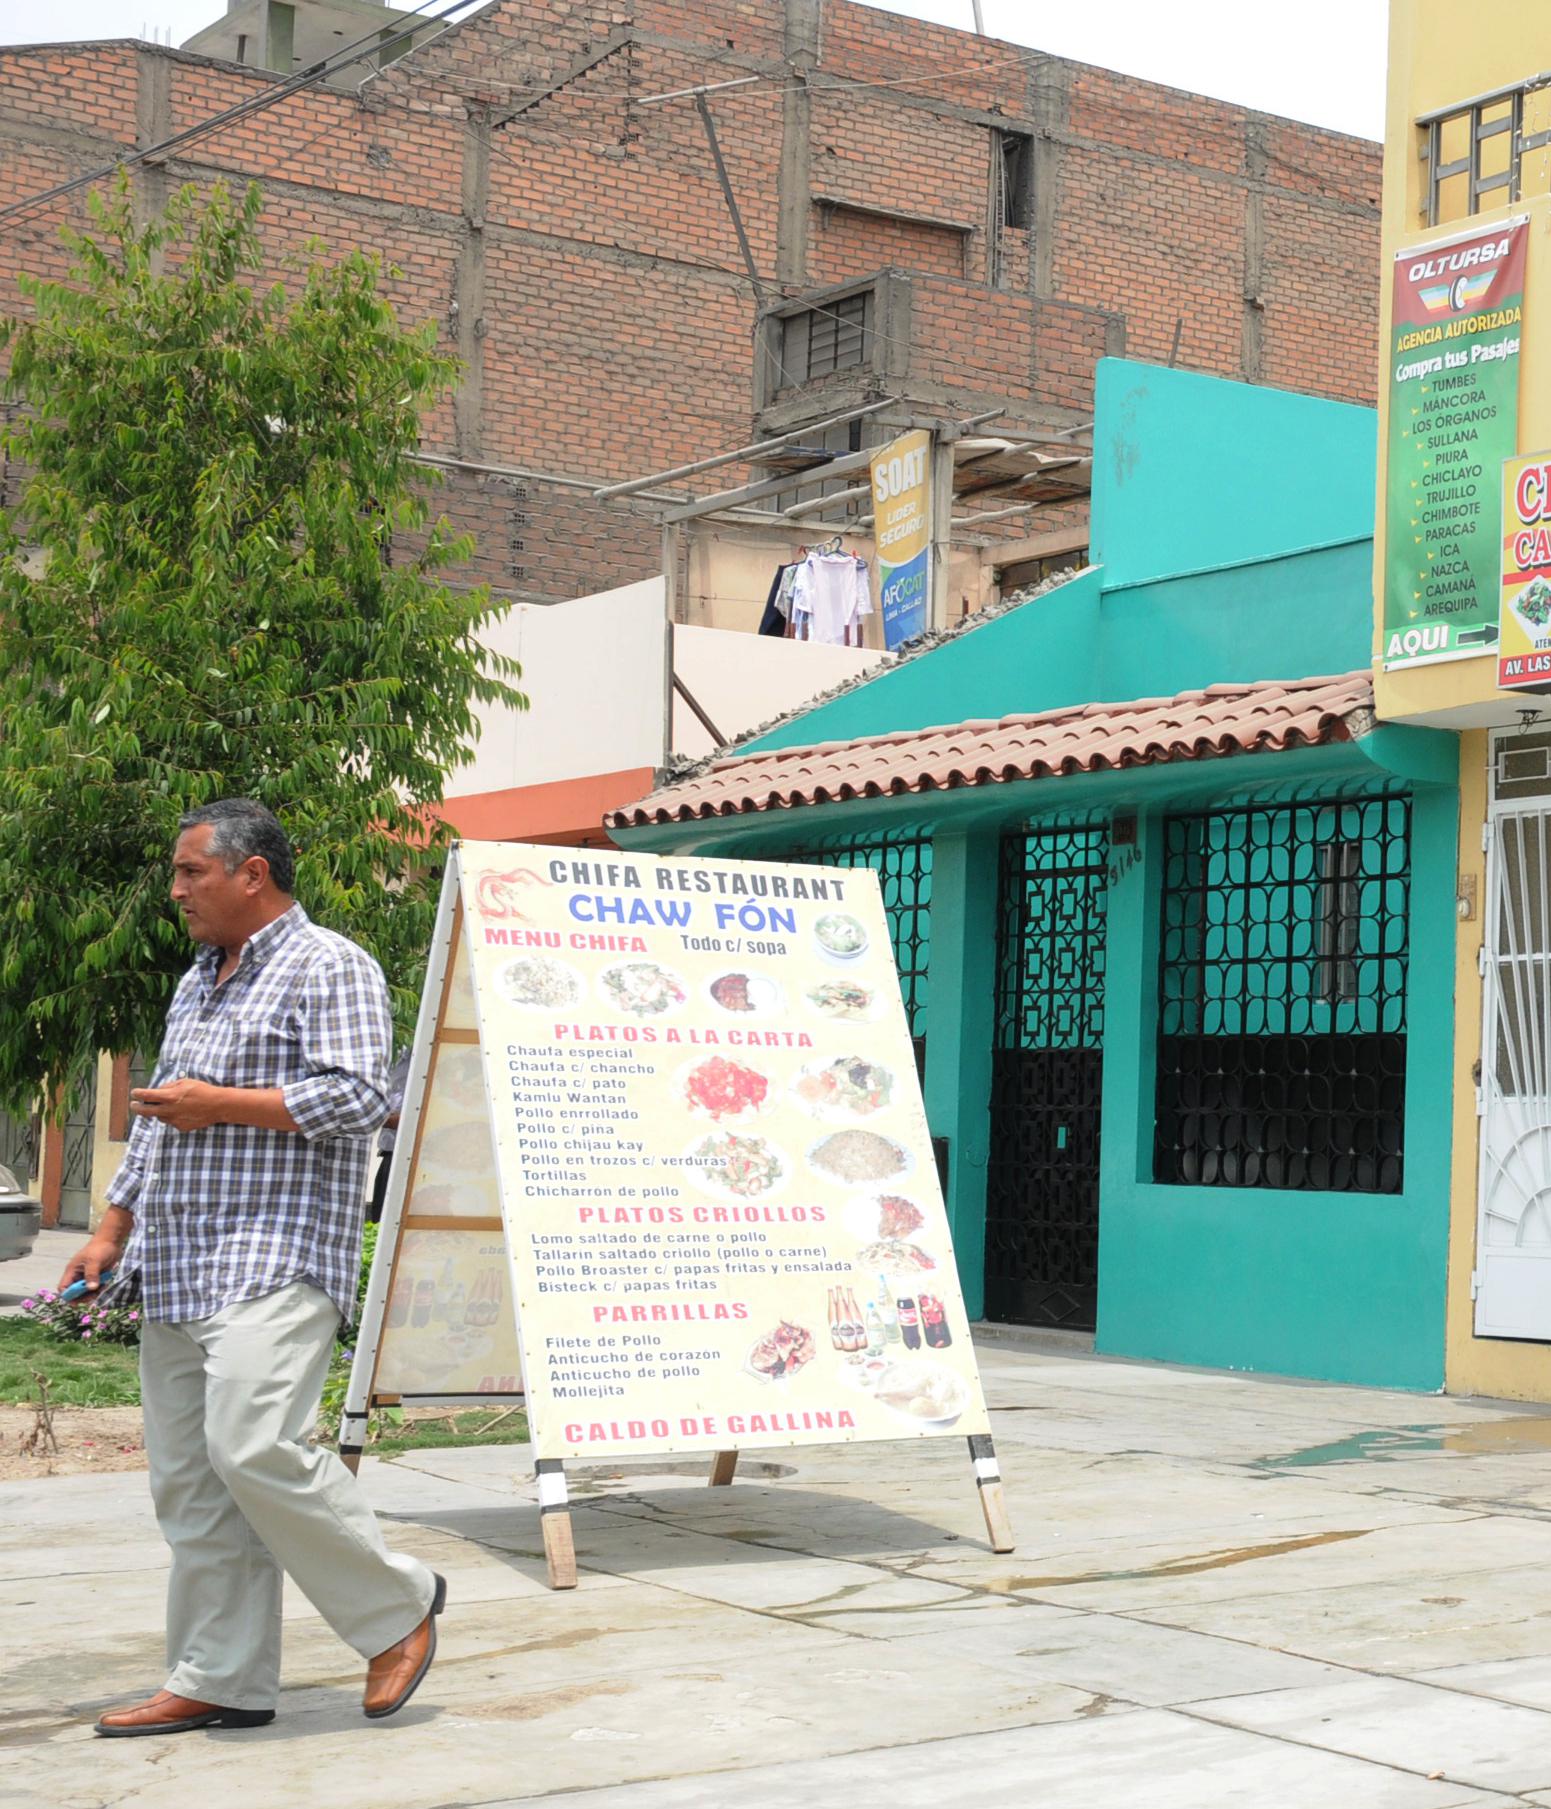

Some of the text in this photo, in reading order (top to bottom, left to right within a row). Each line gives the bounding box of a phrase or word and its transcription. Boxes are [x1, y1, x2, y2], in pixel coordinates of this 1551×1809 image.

[1409, 239, 1509, 282] OLTURSA
[1398, 307, 1521, 353] AGENCIA AUTORIZADA
[1396, 354, 1443, 382] Compra
[1445, 350, 1468, 368] tus
[1432, 374, 1476, 392] TUMBES
[1413, 419, 1431, 434] LOS
[1428, 428, 1478, 449] SULLANA
[1436, 449, 1468, 466] PIURA
[875, 448, 926, 504] SOAT
[1422, 465, 1482, 487] CHICLAYO
[1427, 485, 1476, 504] TRUJILLO
[1422, 502, 1480, 524] CHIMBOTE
[1425, 522, 1476, 542] PARACAS
[1440, 544, 1460, 557] ICA
[1431, 560, 1469, 578] NAZCA
[1424, 599, 1478, 617] AREQUIPA
[1387, 624, 1448, 658] AQUI
[1505, 658, 1524, 675] AV.
[1527, 654, 1550, 672] LAS
[549, 860, 844, 901] CHIFA RESTAURANT
[569, 894, 796, 933] CHAW FÓN
[485, 928, 647, 952] MENU CHIFA
[681, 935, 787, 955] Todo c/ sopa
[555, 1024, 813, 1047] PLATOS A LA CARTA
[569, 1047, 633, 1059] especial
[514, 1107, 638, 1120] Pollo enrrollado
[519, 1138, 558, 1149] Pollo
[617, 1139, 643, 1152] kay
[523, 1170, 586, 1181] Tortillas
[618, 1186, 636, 1197] de
[642, 1186, 679, 1198] pollo
[579, 1206, 825, 1223] PLATOS CRIOLLOS
[532, 1231, 766, 1244] Lomo saltado de carne o pollo
[593, 1302, 748, 1323] PARRILLAS
[546, 1334, 661, 1348] Filete de Pollo
[551, 1365, 700, 1382] Anticucho de pollo
[553, 1385, 625, 1398] Mollejita
[565, 1410, 855, 1443] CALDO DE GALLINA
